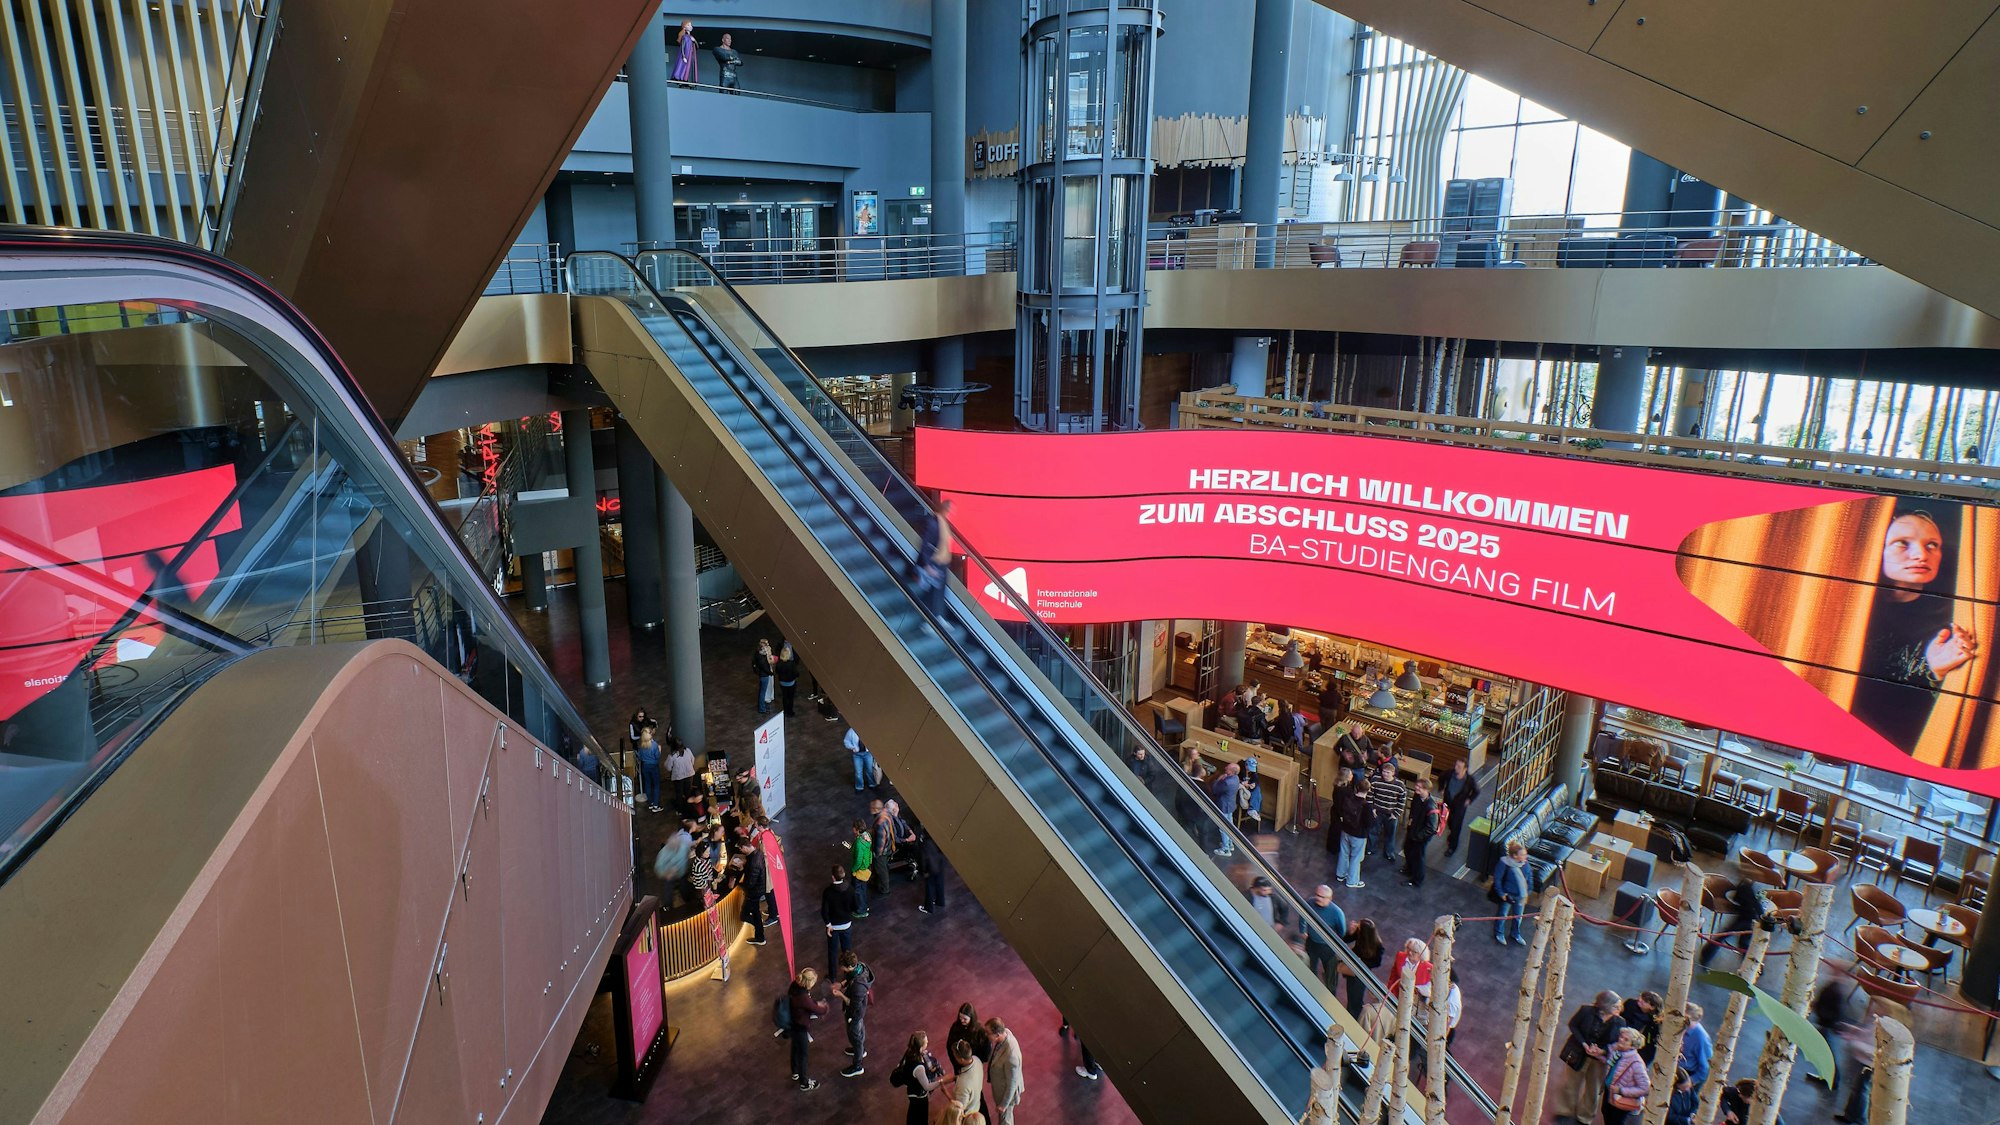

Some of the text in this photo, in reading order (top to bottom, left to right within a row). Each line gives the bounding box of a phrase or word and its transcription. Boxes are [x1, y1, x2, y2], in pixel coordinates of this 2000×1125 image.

[1189, 468, 1630, 540] HERZLICH WILLKOMMEN
[1138, 503, 1501, 559] ZUM ABSCHLUSS 2025
[1249, 533, 1617, 617] BA-STUDIENGANG FILM
[1036, 588, 1098, 599] Internationale
[1036, 599, 1083, 609] Filmschule
[1036, 610, 1057, 619] Köln
